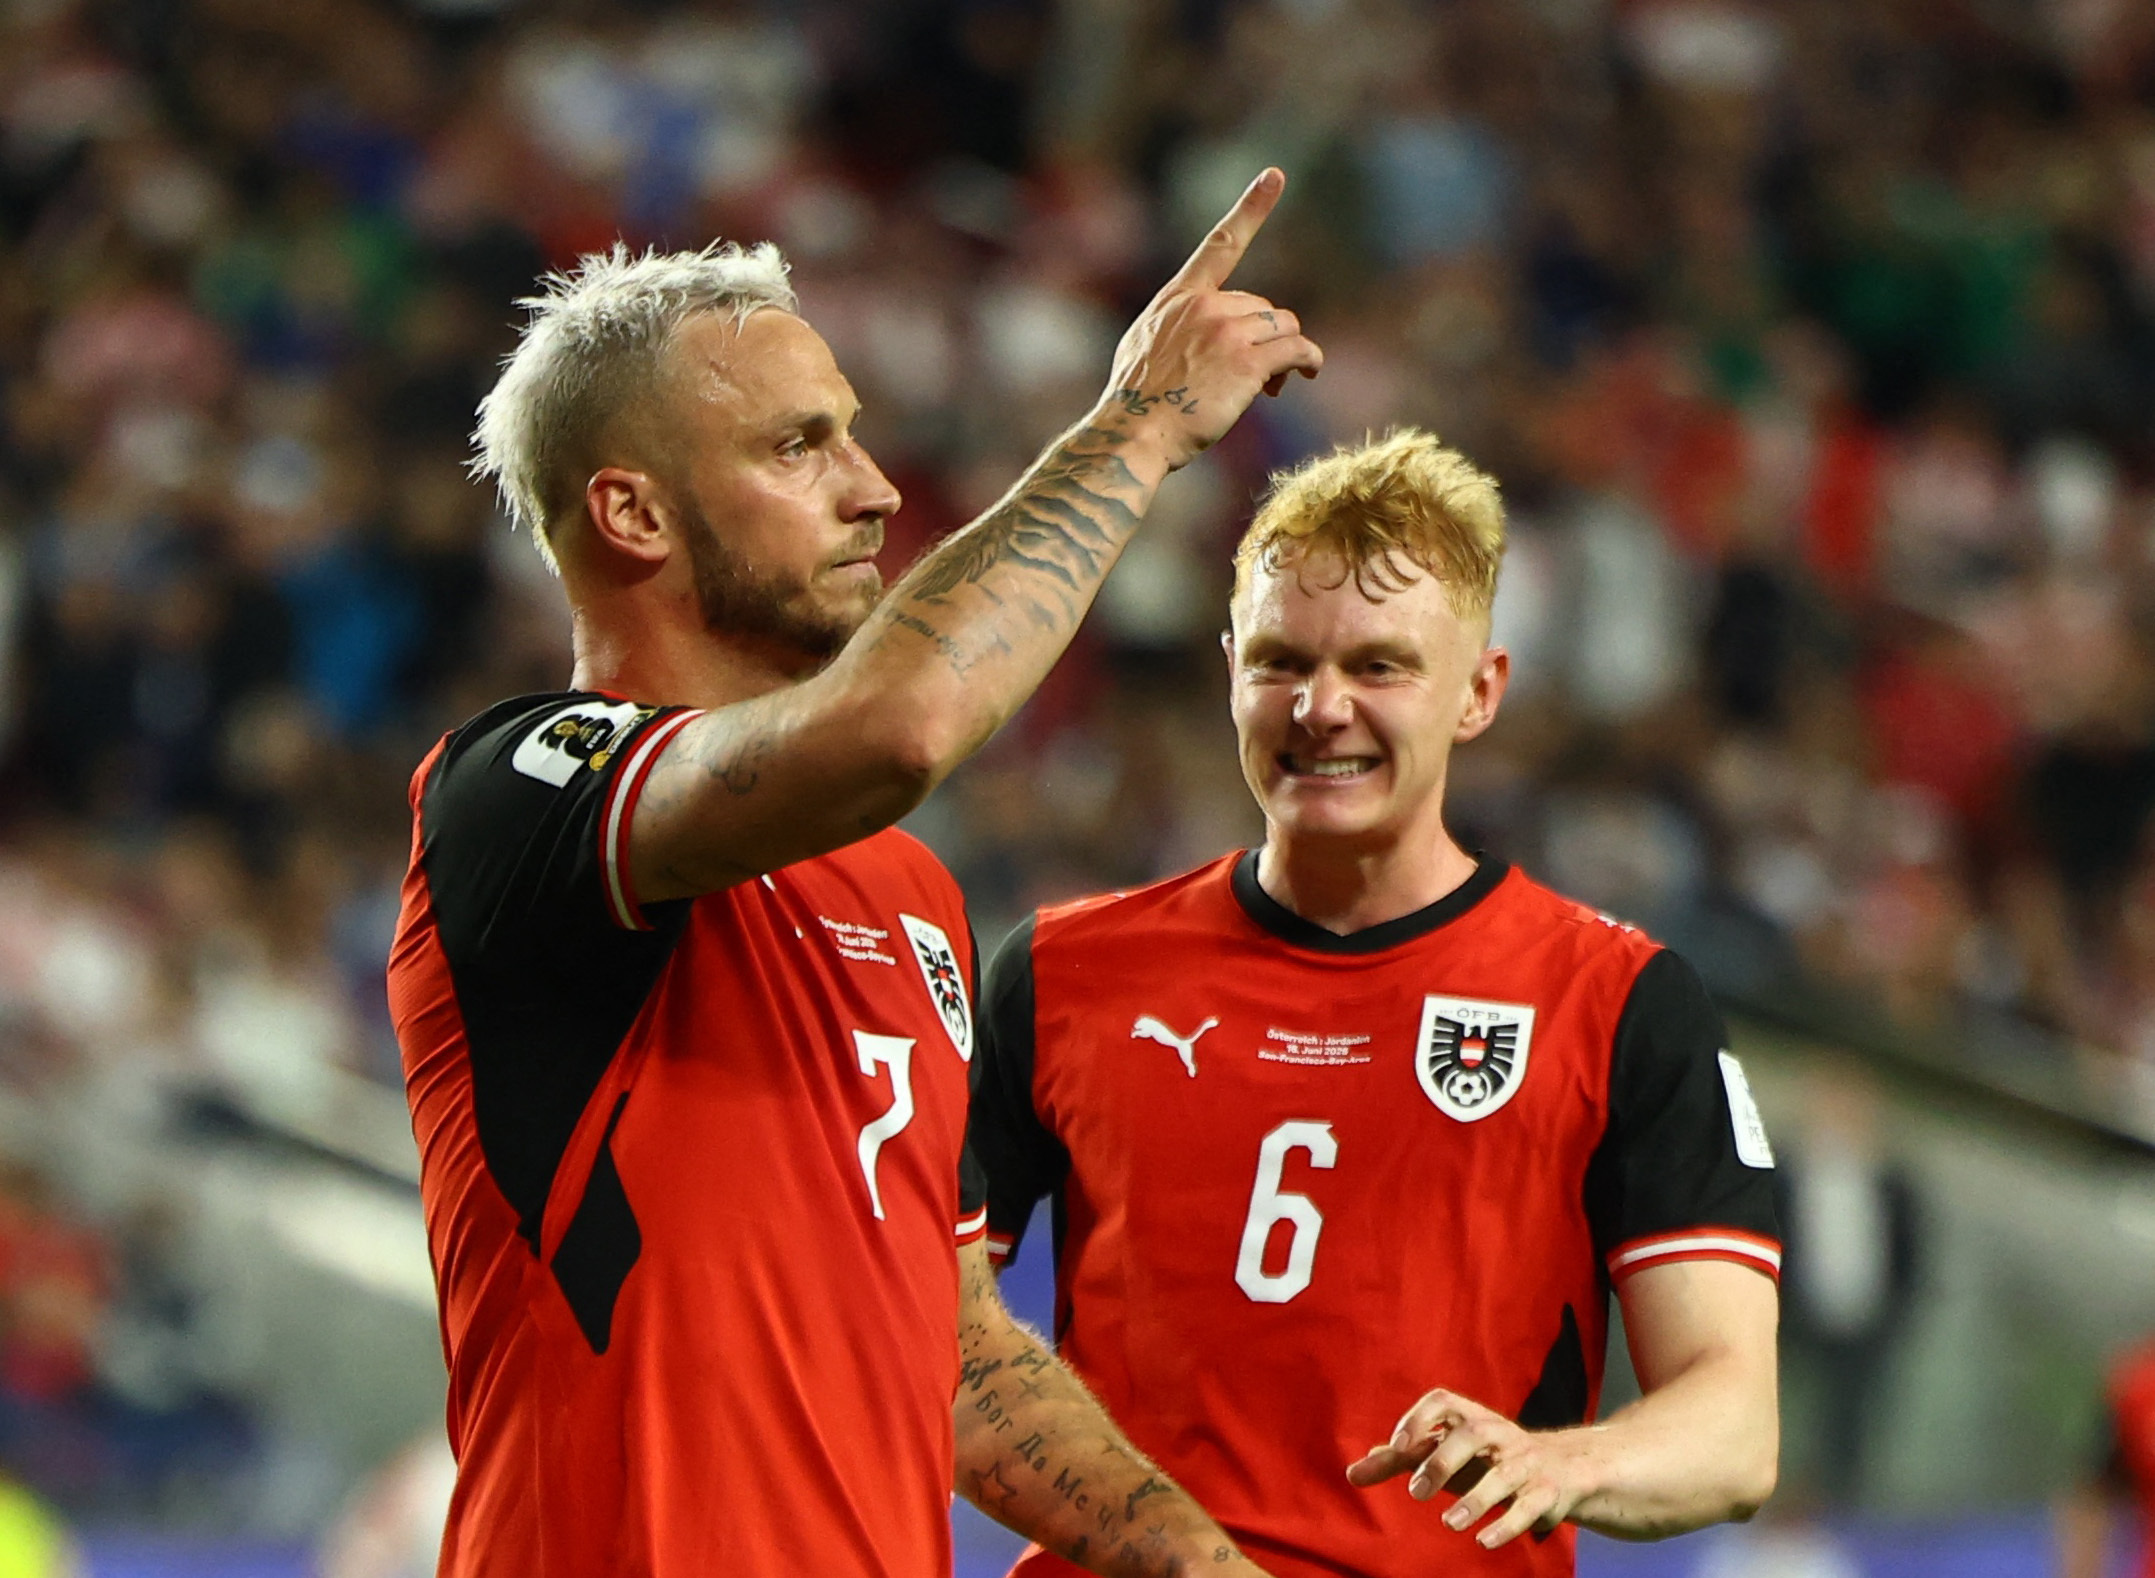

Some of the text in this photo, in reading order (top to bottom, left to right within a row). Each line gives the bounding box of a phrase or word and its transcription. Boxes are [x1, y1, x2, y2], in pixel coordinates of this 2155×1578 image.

[1456, 1008, 1500, 1021] ÖFB
[1266, 1028, 1318, 1046] Österreich
[1301, 1046, 1323, 1056] Juni
[852, 1029, 917, 1221] 7
[1235, 1119, 1338, 1303] 6
